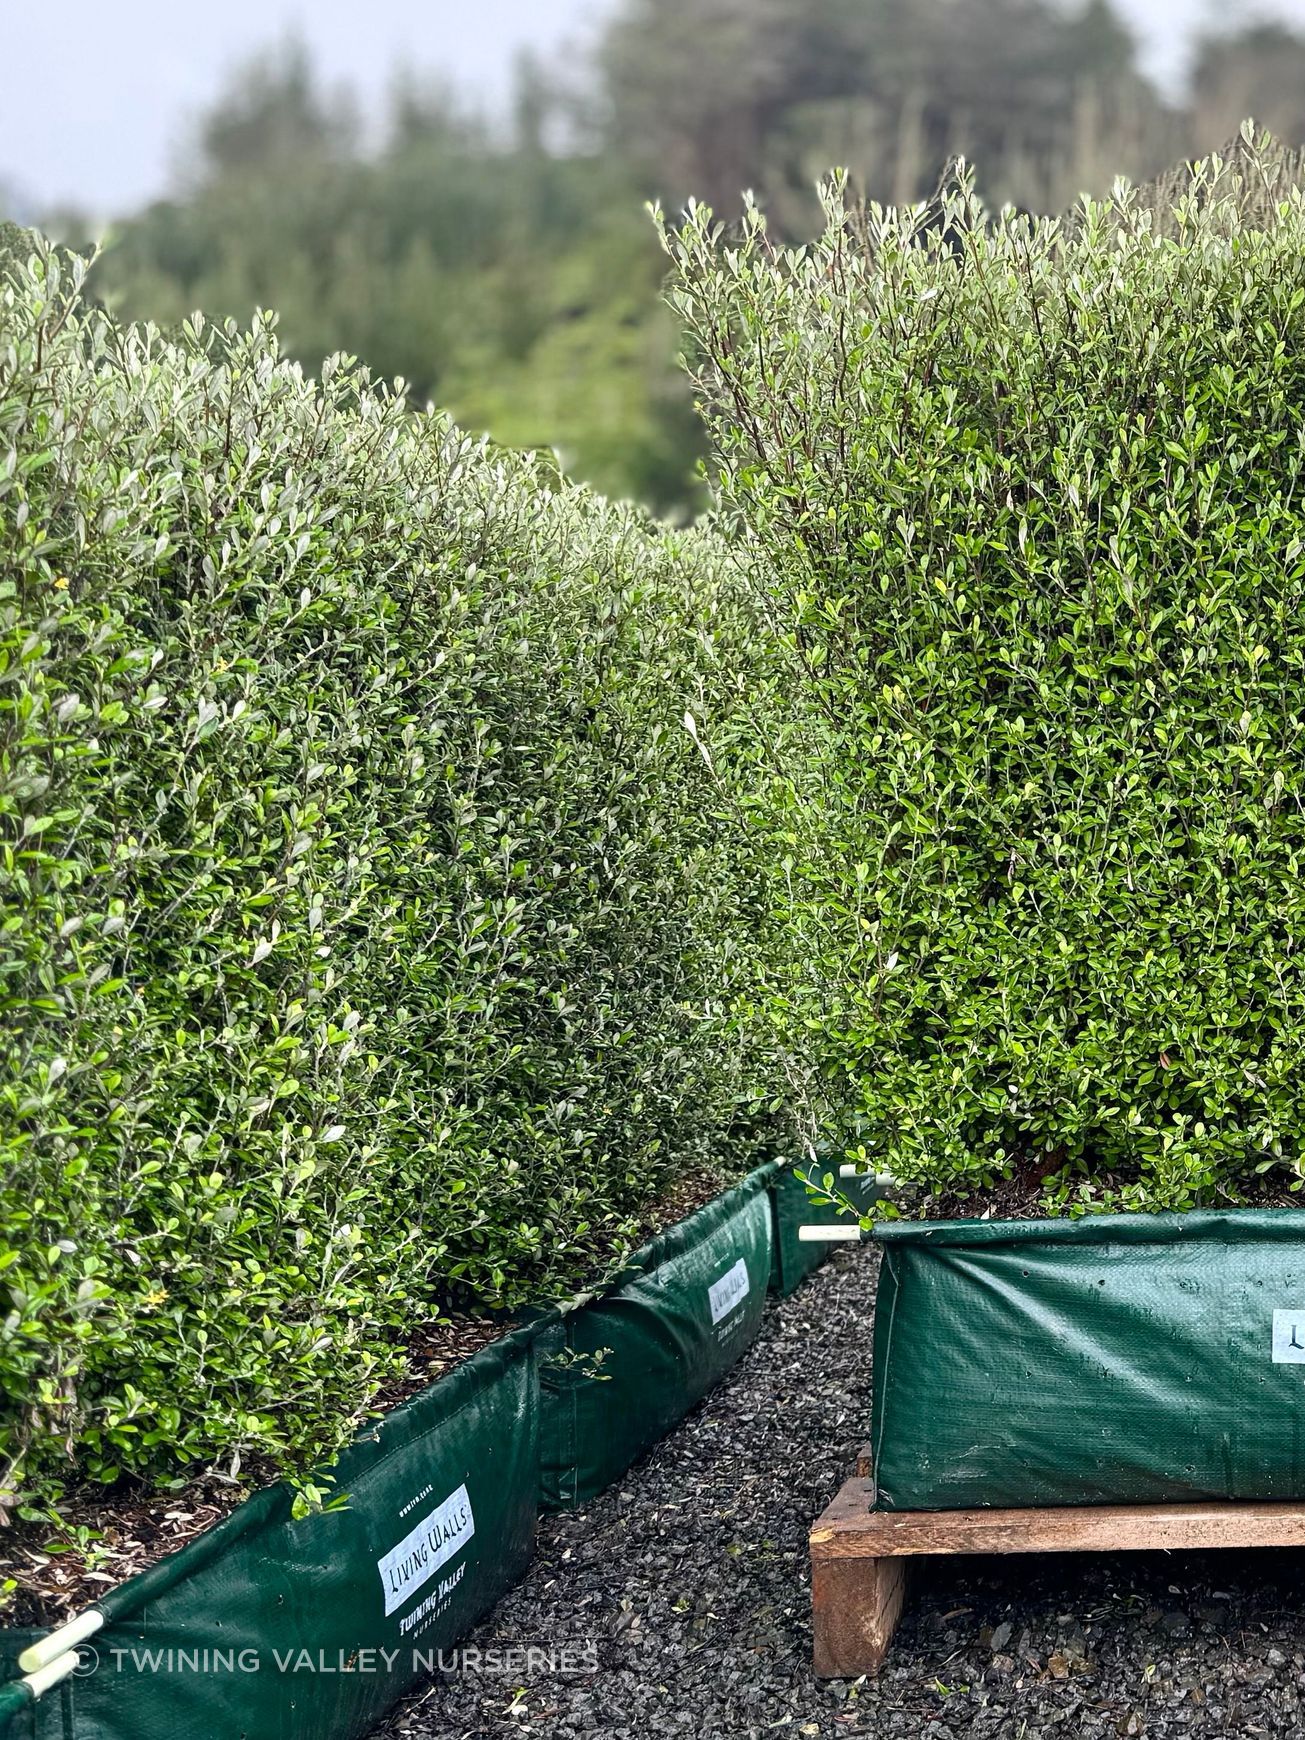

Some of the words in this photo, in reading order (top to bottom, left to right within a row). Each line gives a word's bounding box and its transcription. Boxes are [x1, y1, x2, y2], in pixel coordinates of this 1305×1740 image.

[389, 1542, 428, 1593] LIVING
[427, 1506, 467, 1553] WALLS
[399, 1590, 437, 1637] TWINING
[438, 1561, 467, 1603] VALLEY
